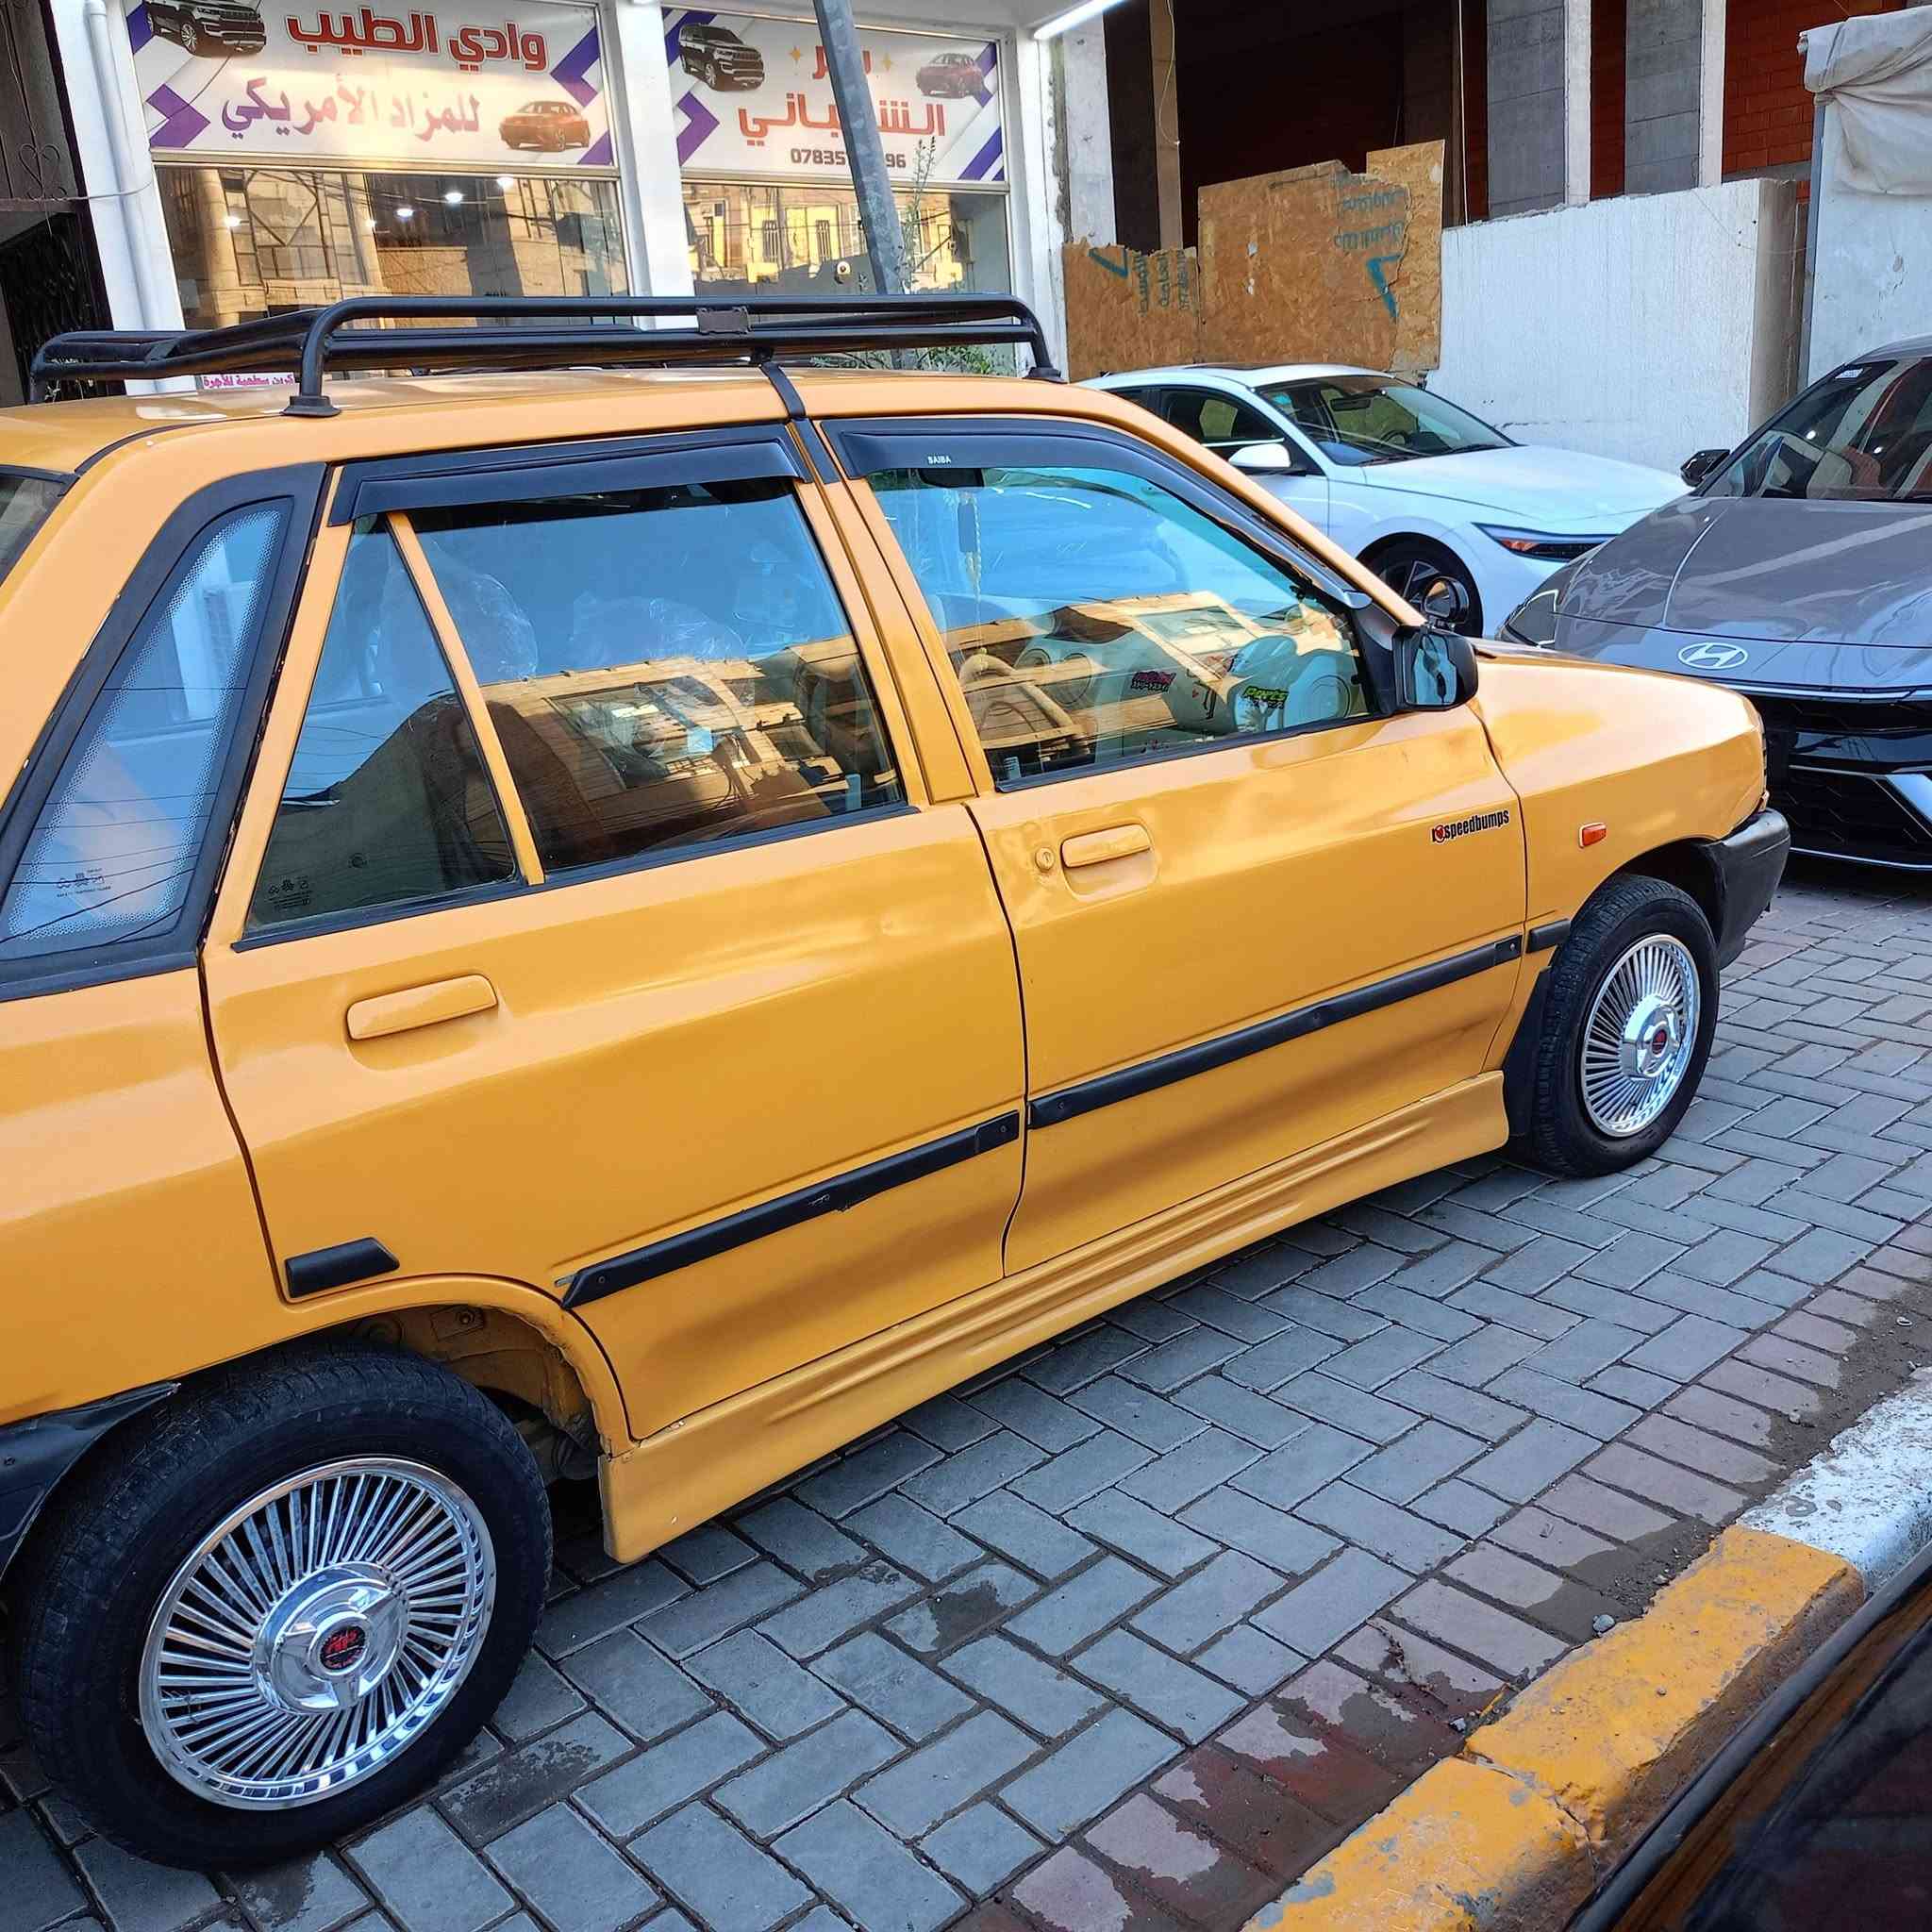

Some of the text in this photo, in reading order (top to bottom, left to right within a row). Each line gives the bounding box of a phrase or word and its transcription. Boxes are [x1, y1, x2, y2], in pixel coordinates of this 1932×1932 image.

[286, 8, 548, 72] وادي الطيب
[222, 74, 480, 142] للمزاد الأمريكي
[738, 92, 945, 146] الشباني
[791, 147, 907, 168] 0783596
[1444, 810, 1509, 840] speedbumps
